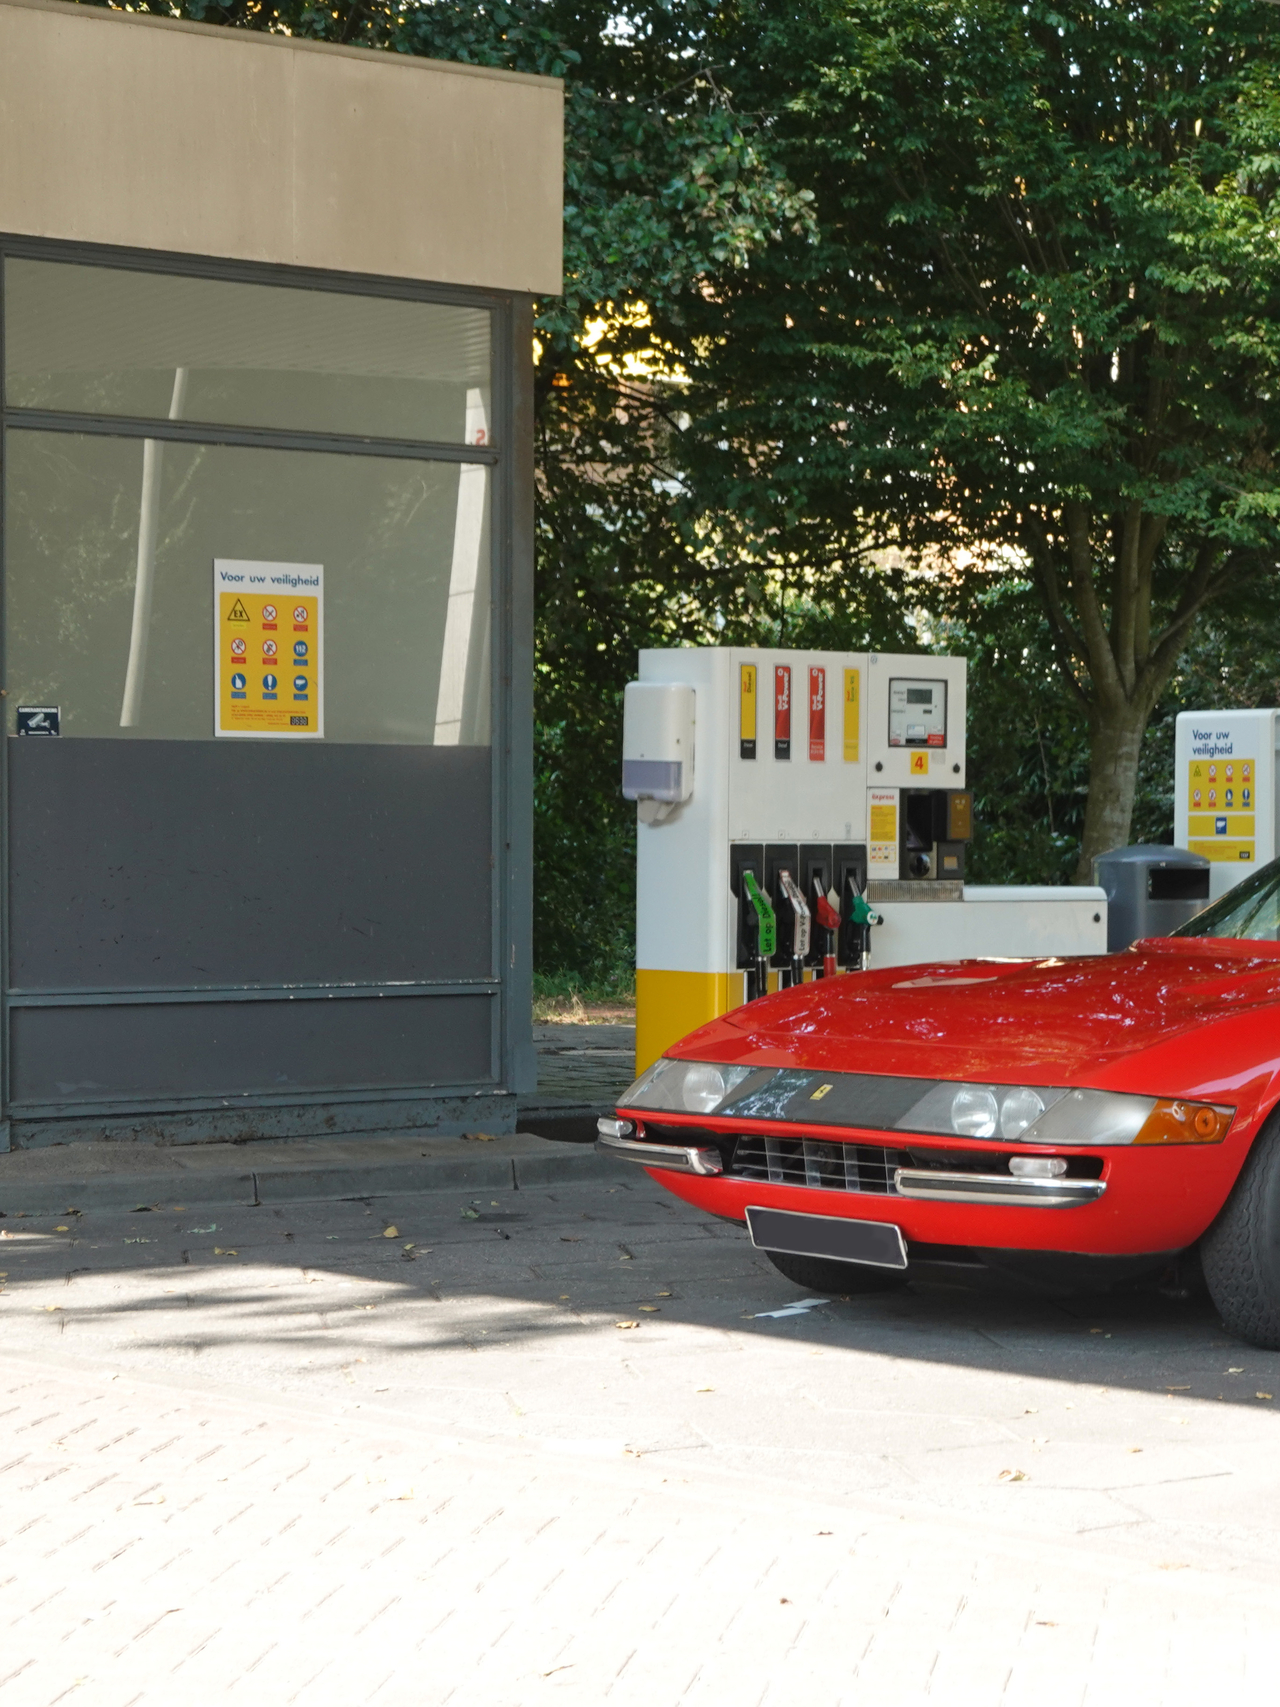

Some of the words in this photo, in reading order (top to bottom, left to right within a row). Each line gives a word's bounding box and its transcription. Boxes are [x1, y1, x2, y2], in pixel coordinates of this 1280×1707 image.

[220, 571, 245, 582] Voor
[250, 575, 266, 584] uw
[270, 573, 320, 588] veiligheid
[233, 609, 244, 618] EX
[295, 645, 306, 653] 112
[1192, 729, 1212, 740] Voor
[1216, 731, 1230, 740] uw
[1192, 742, 1233, 758] veiligheid
[915, 756, 924, 770] 4
[765, 923, 773, 934] op
[801, 929, 807, 938] op
